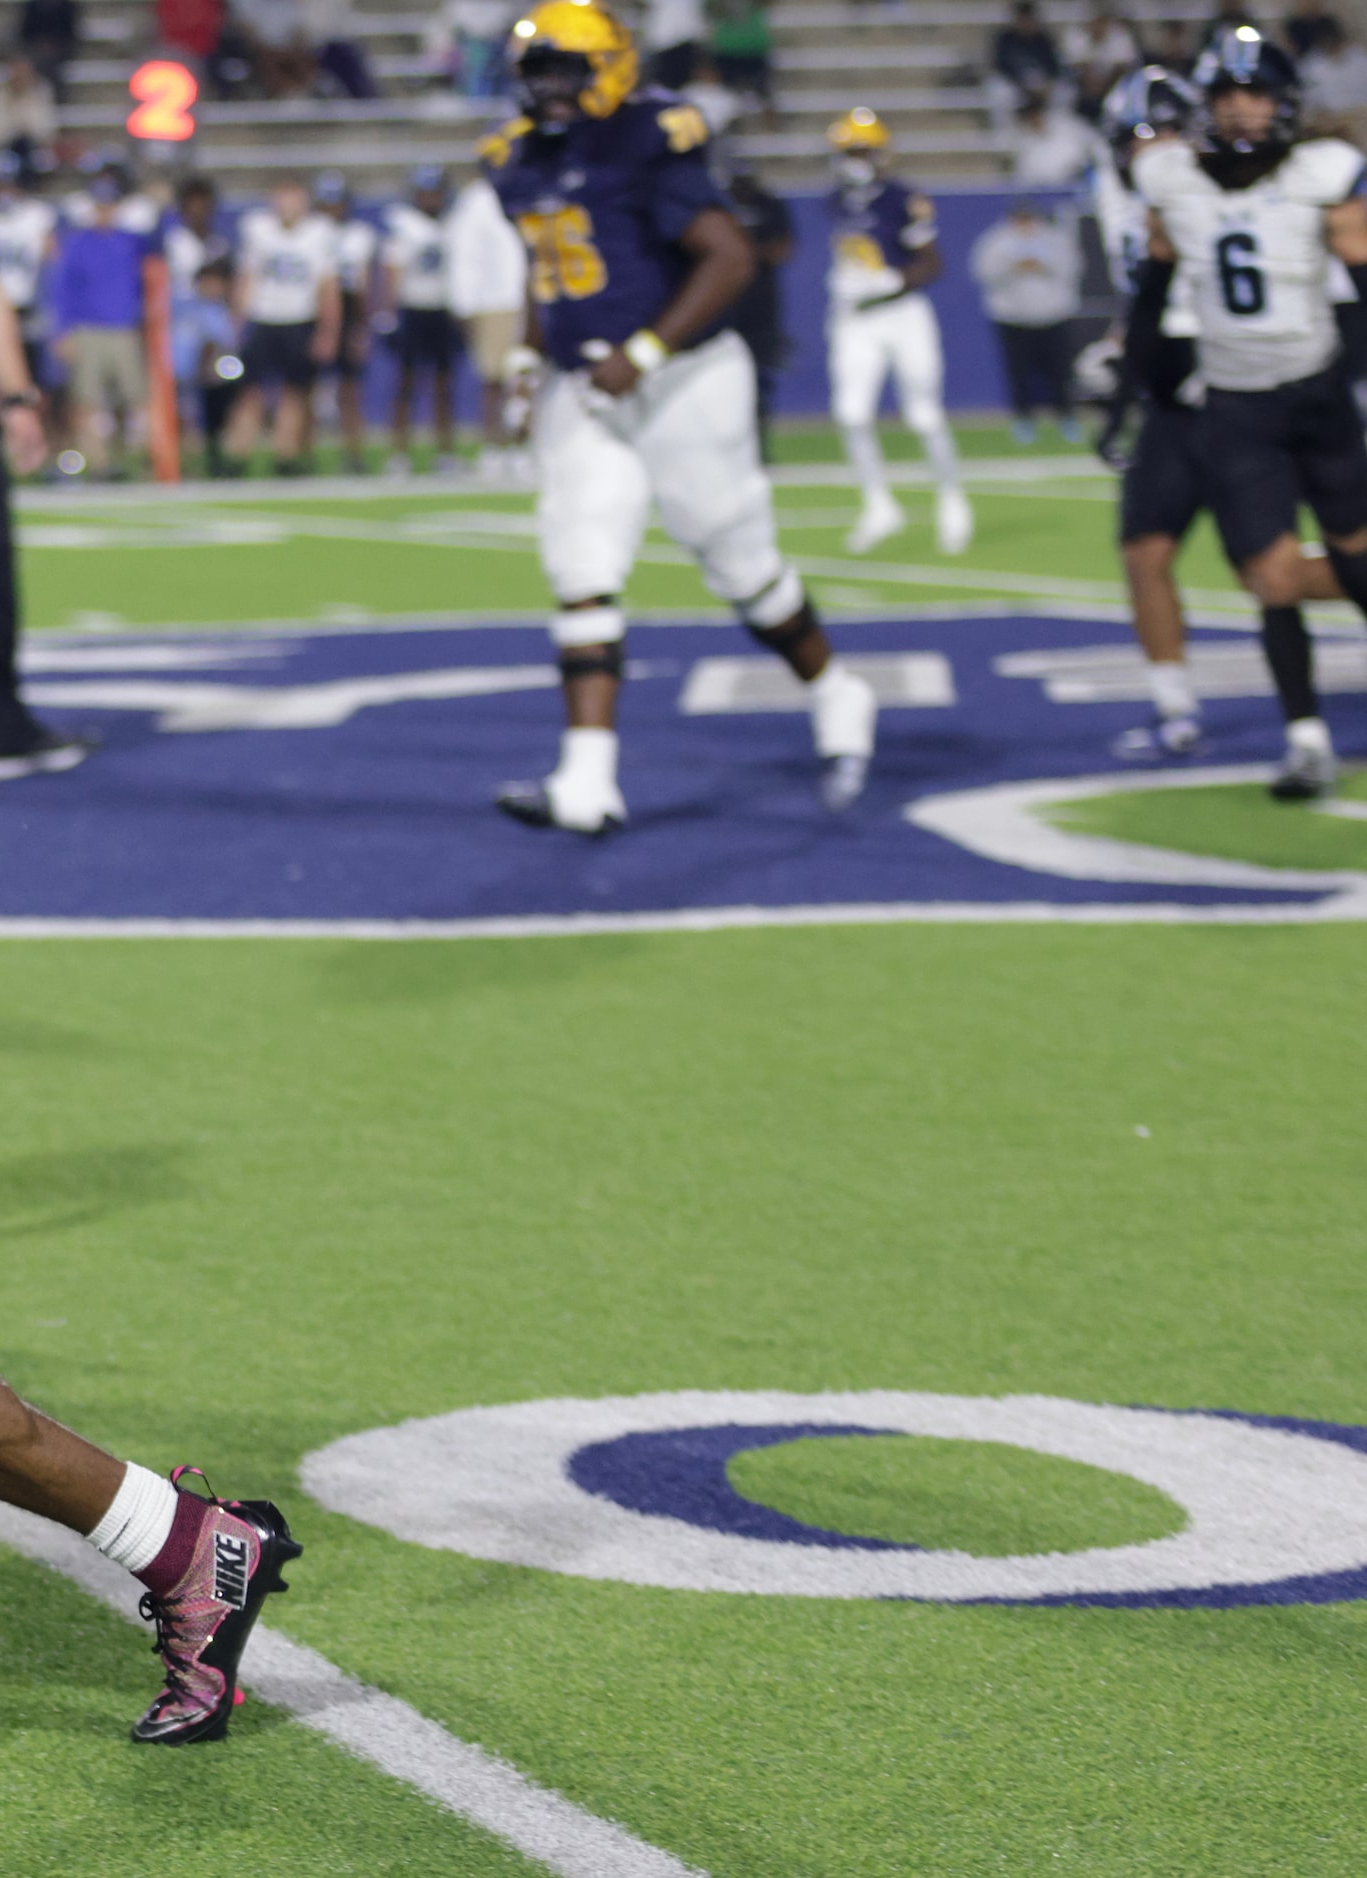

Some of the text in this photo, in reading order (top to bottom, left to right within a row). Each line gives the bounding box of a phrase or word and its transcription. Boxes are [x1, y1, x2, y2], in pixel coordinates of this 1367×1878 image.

[127, 60, 199, 142] 2
[1216, 231, 1266, 317] 6
[214, 1532, 248, 1610] NIKE
